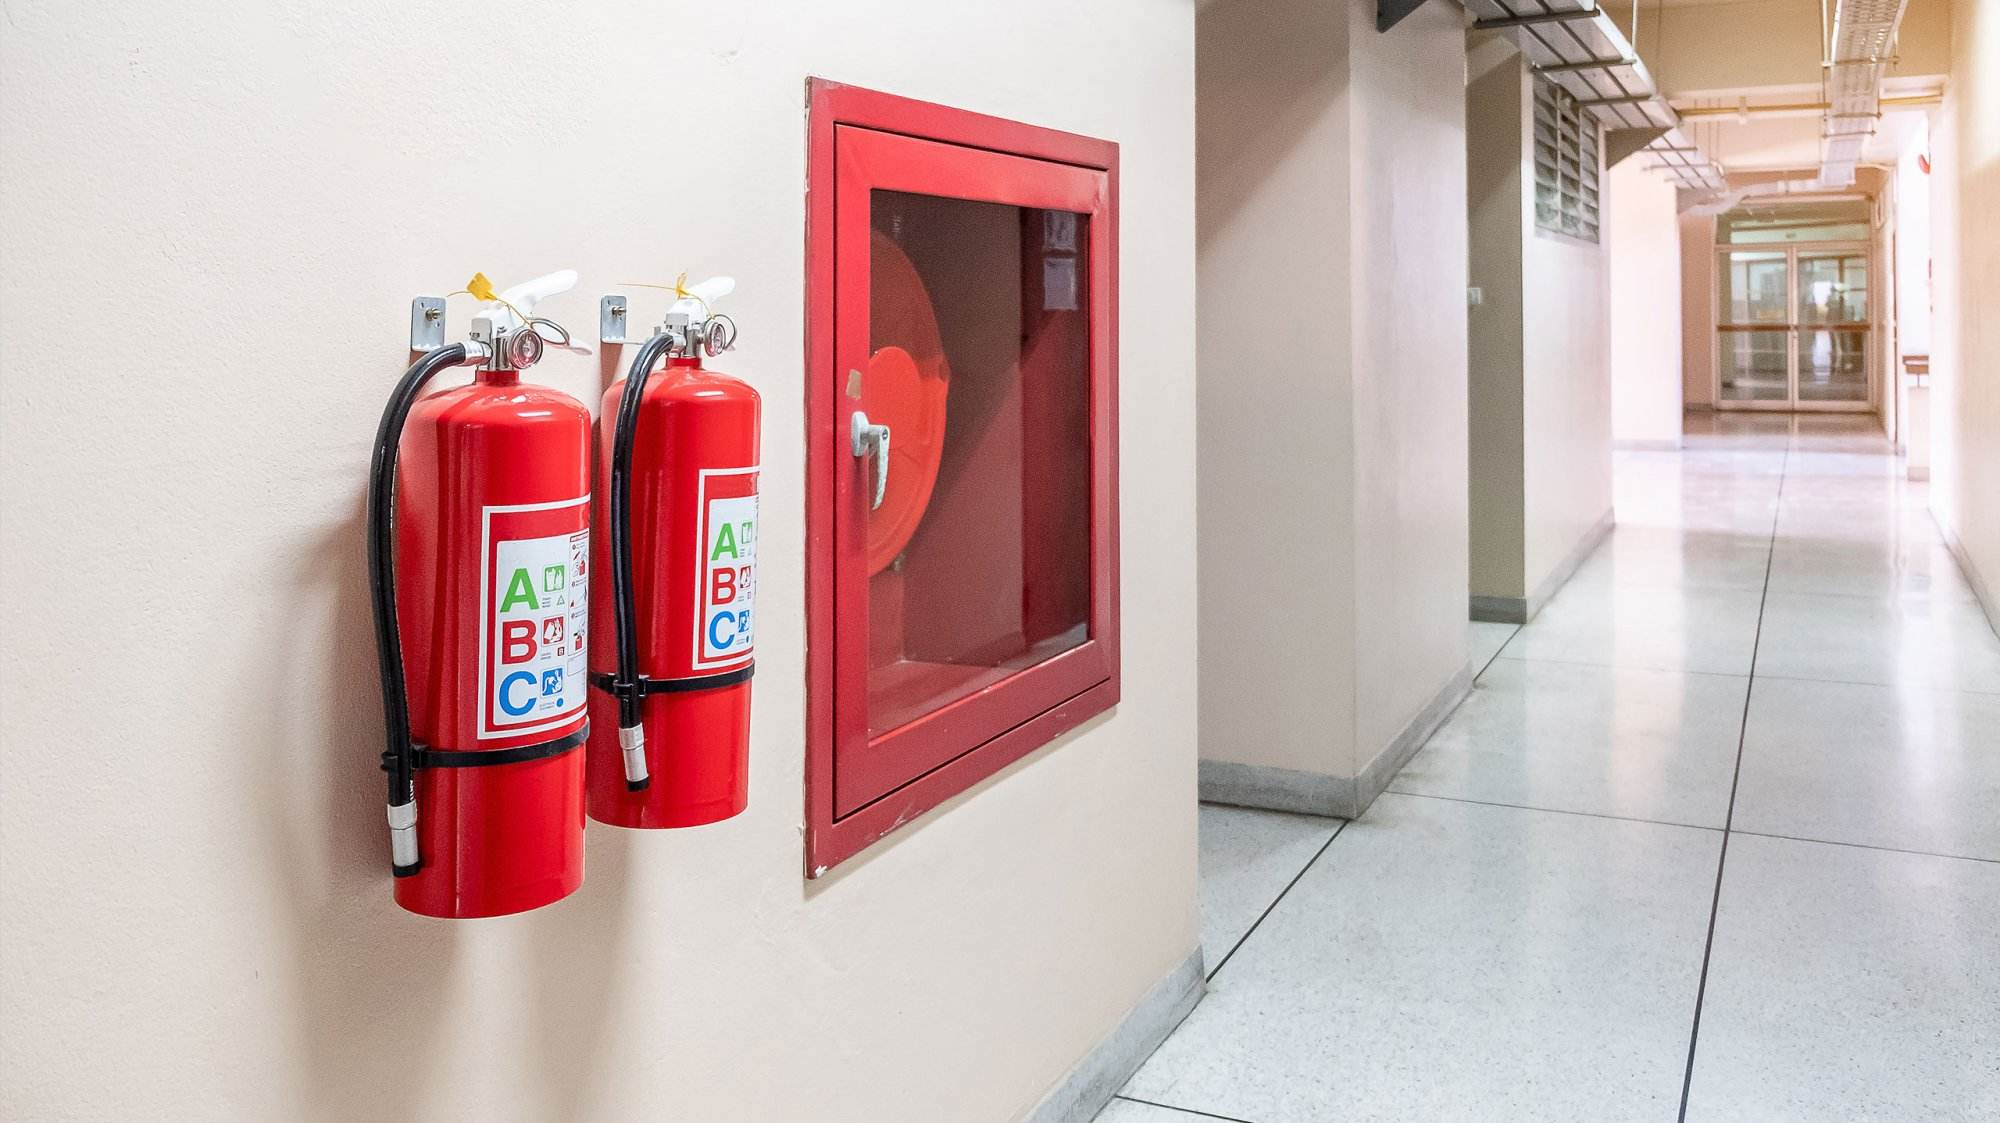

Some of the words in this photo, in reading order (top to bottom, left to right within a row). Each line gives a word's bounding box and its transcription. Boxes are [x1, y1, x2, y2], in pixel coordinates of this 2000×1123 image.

[711, 523, 738, 561] A
[500, 568, 539, 613] A
[711, 567, 737, 606] B
[502, 620, 538, 665] B
[708, 611, 736, 650] C
[499, 671, 538, 717] C
